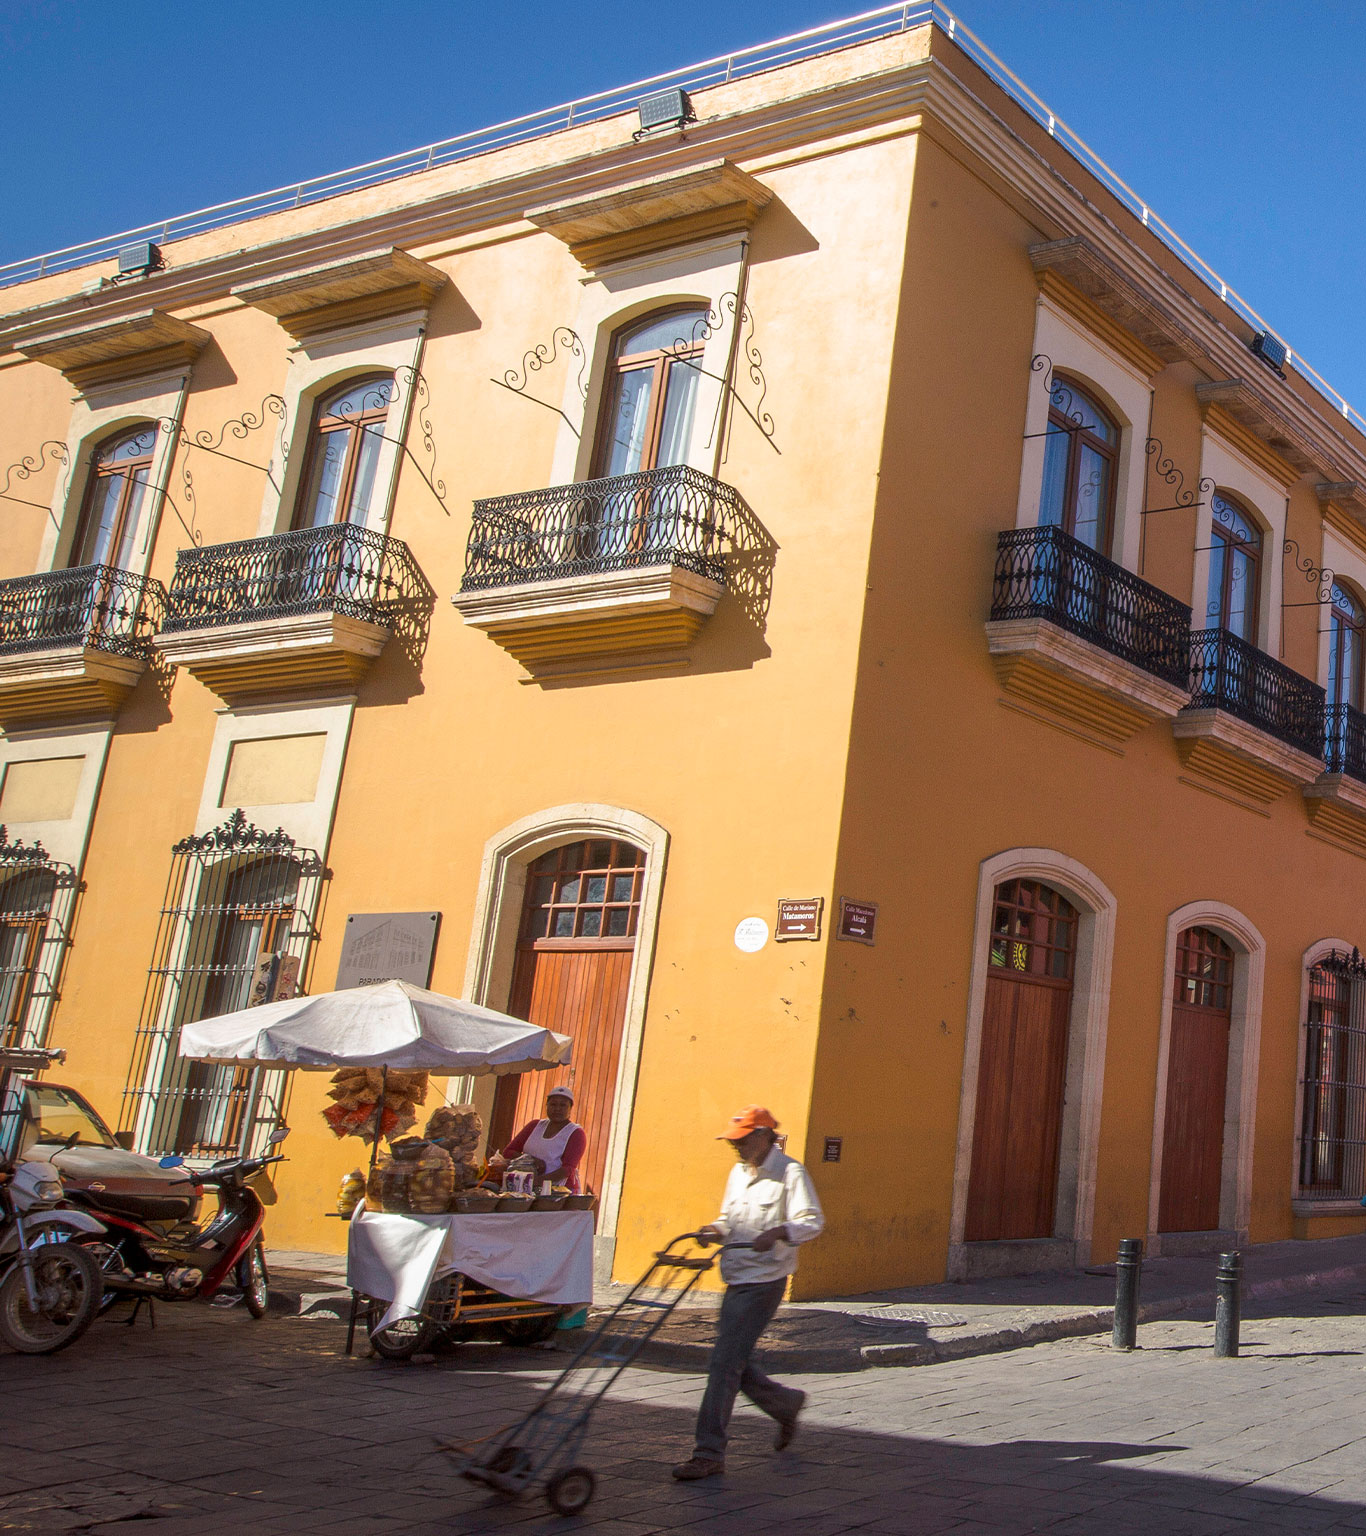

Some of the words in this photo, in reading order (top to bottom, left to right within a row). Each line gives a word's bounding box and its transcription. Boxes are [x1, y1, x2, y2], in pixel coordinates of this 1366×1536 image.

[845, 905, 855, 913] Calle
[782, 912, 815, 920] Matamoros
[852, 914, 867, 924] Alcalá
